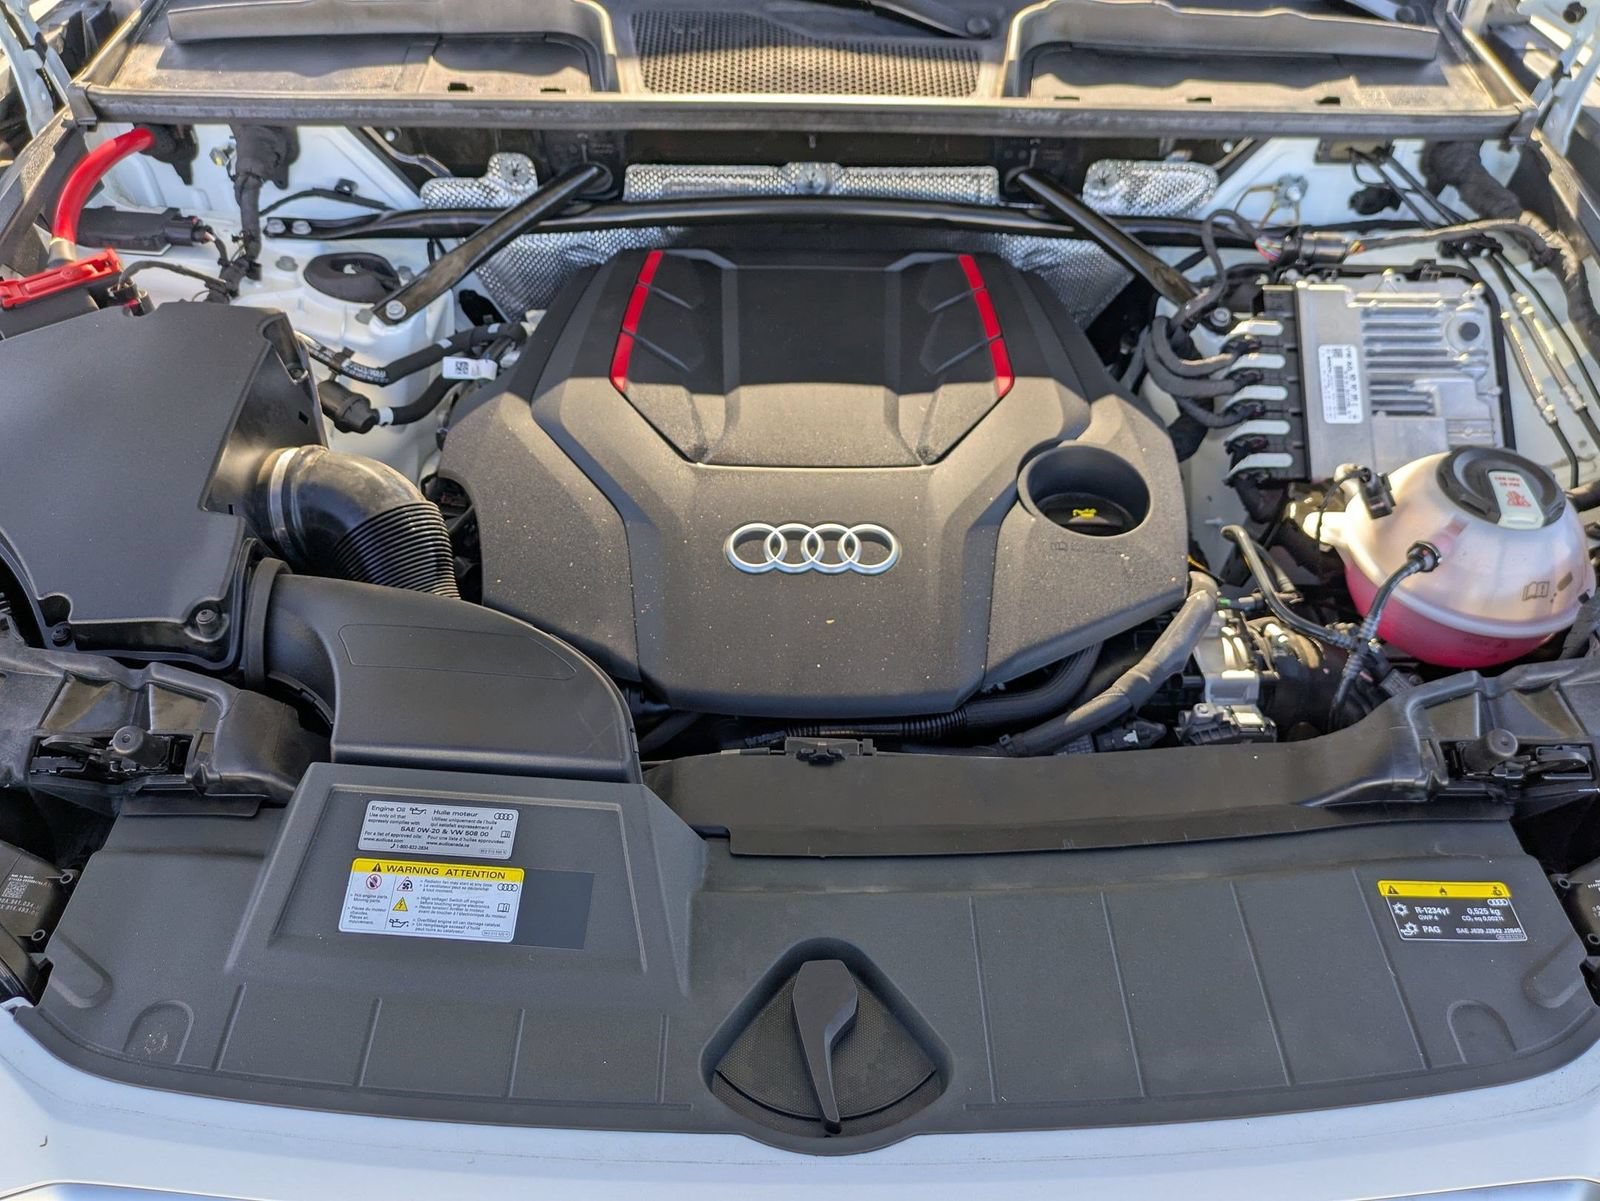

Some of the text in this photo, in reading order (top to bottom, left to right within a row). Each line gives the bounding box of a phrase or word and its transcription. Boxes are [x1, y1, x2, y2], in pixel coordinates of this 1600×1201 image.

[386, 865, 506, 879] WARNING ATTENTION
[1415, 906, 1450, 916] R-1234yf
